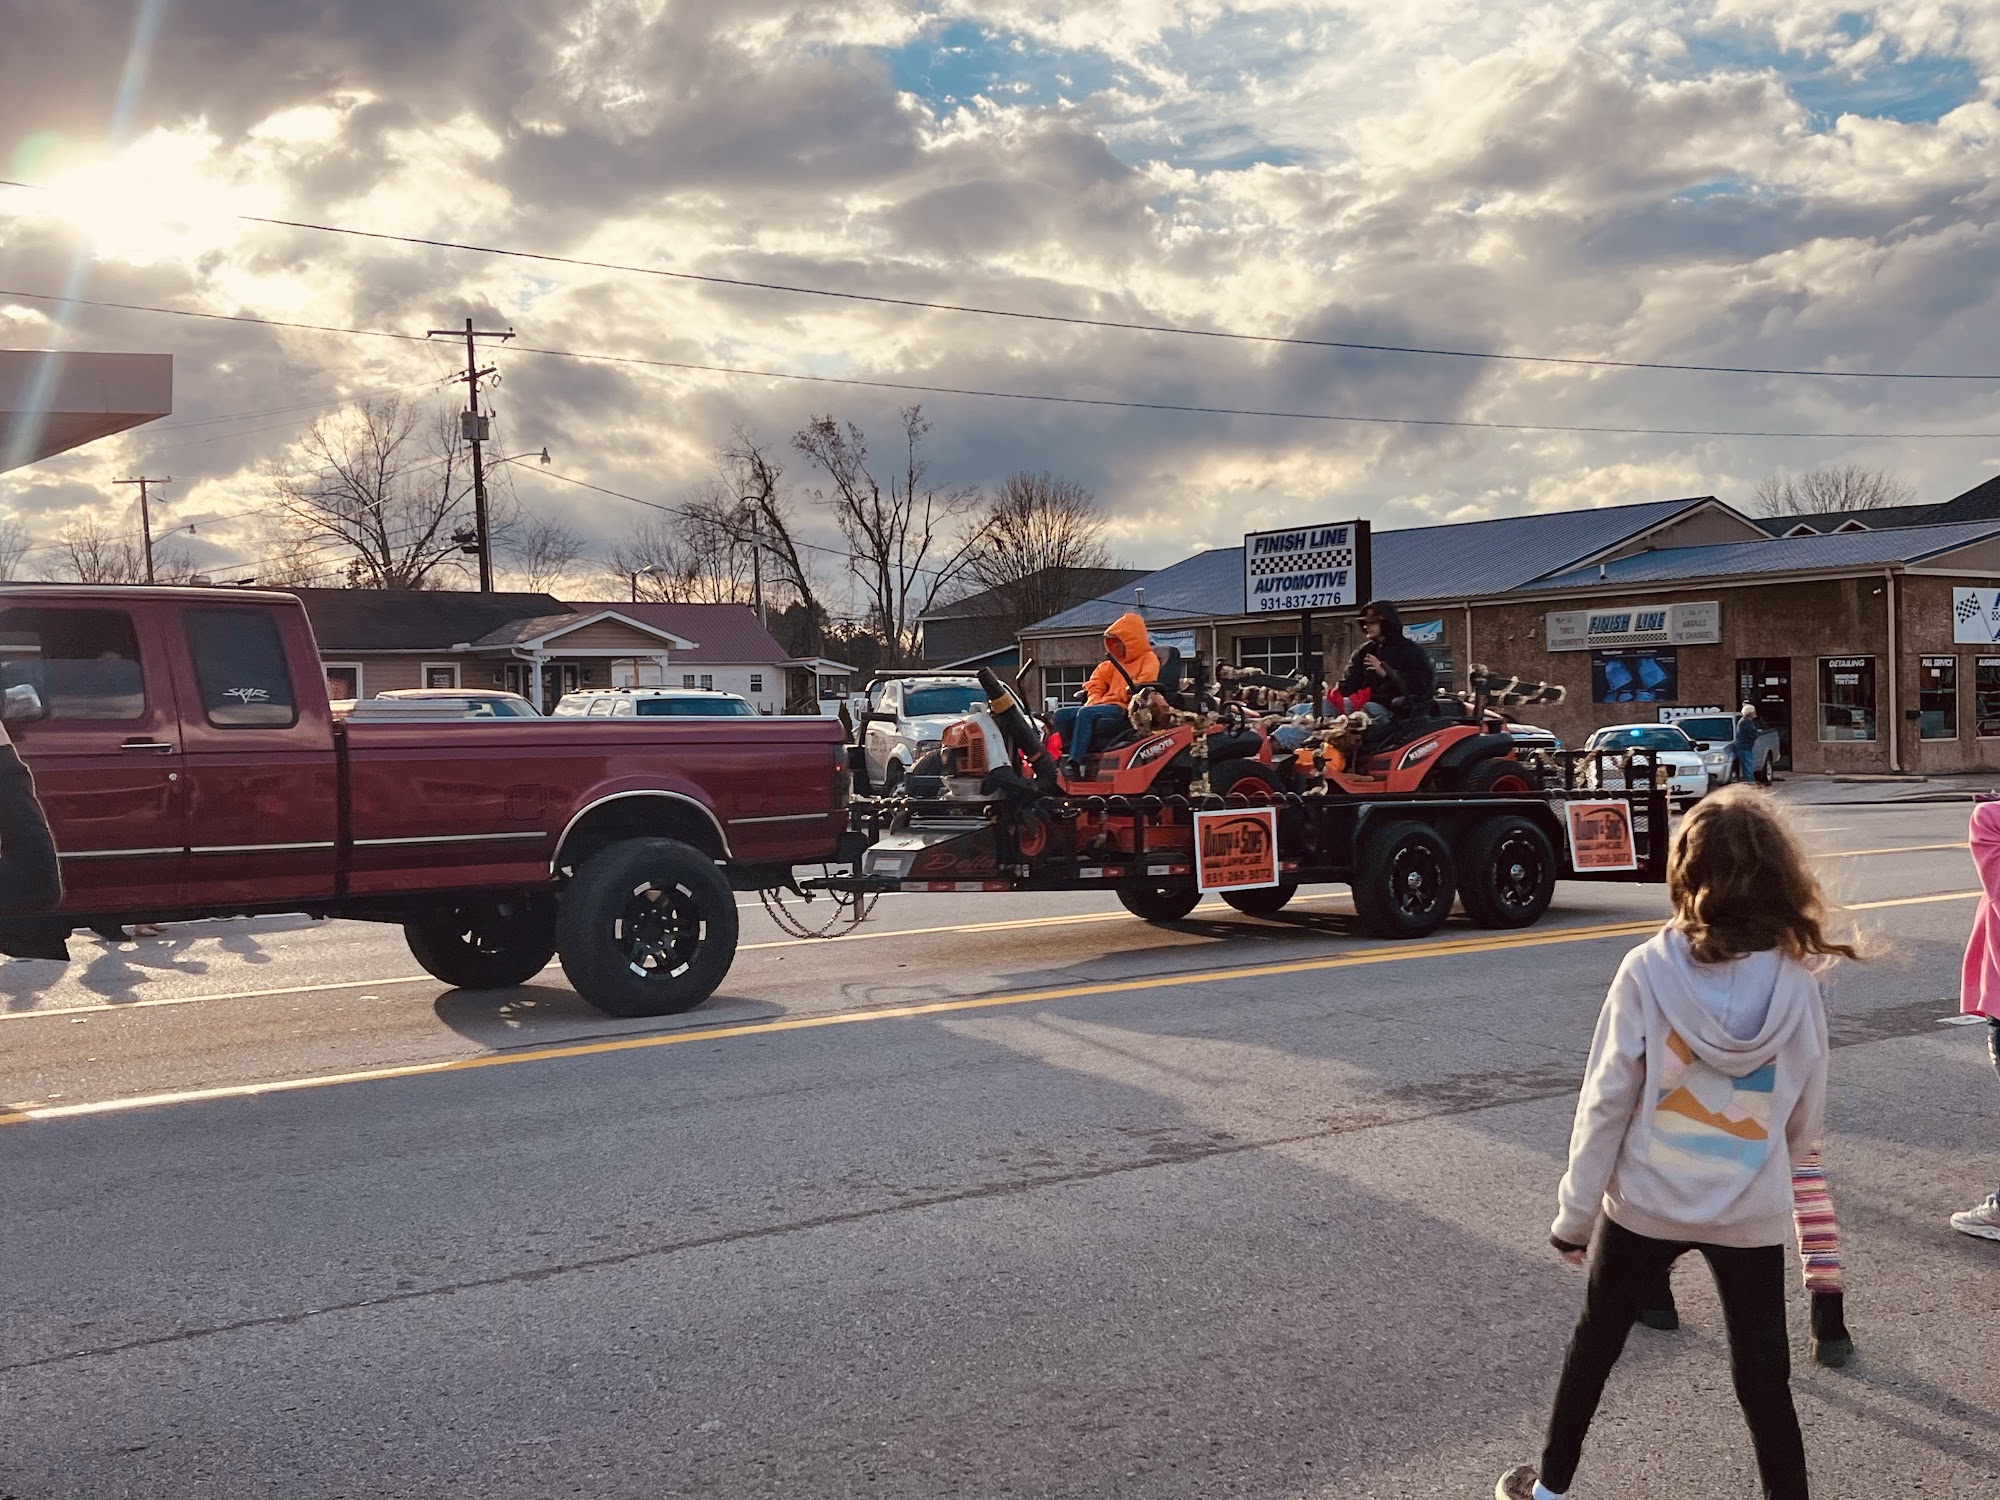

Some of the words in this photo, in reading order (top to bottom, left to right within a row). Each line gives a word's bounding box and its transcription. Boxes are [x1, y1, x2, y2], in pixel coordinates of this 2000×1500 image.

[1254, 532, 1306, 555] FINISH
[1310, 527, 1348, 549] LINE
[1254, 570, 1347, 594] AUTOMOTIVE
[1261, 592, 1341, 610] 931-837-2776
[1588, 613, 1631, 634] FINISH
[1635, 611, 1666, 631] LINE
[1829, 659, 1865, 668] DETAILING
[222, 688, 270, 704] SKAR
[1139, 738, 1174, 760] KUBOTA
